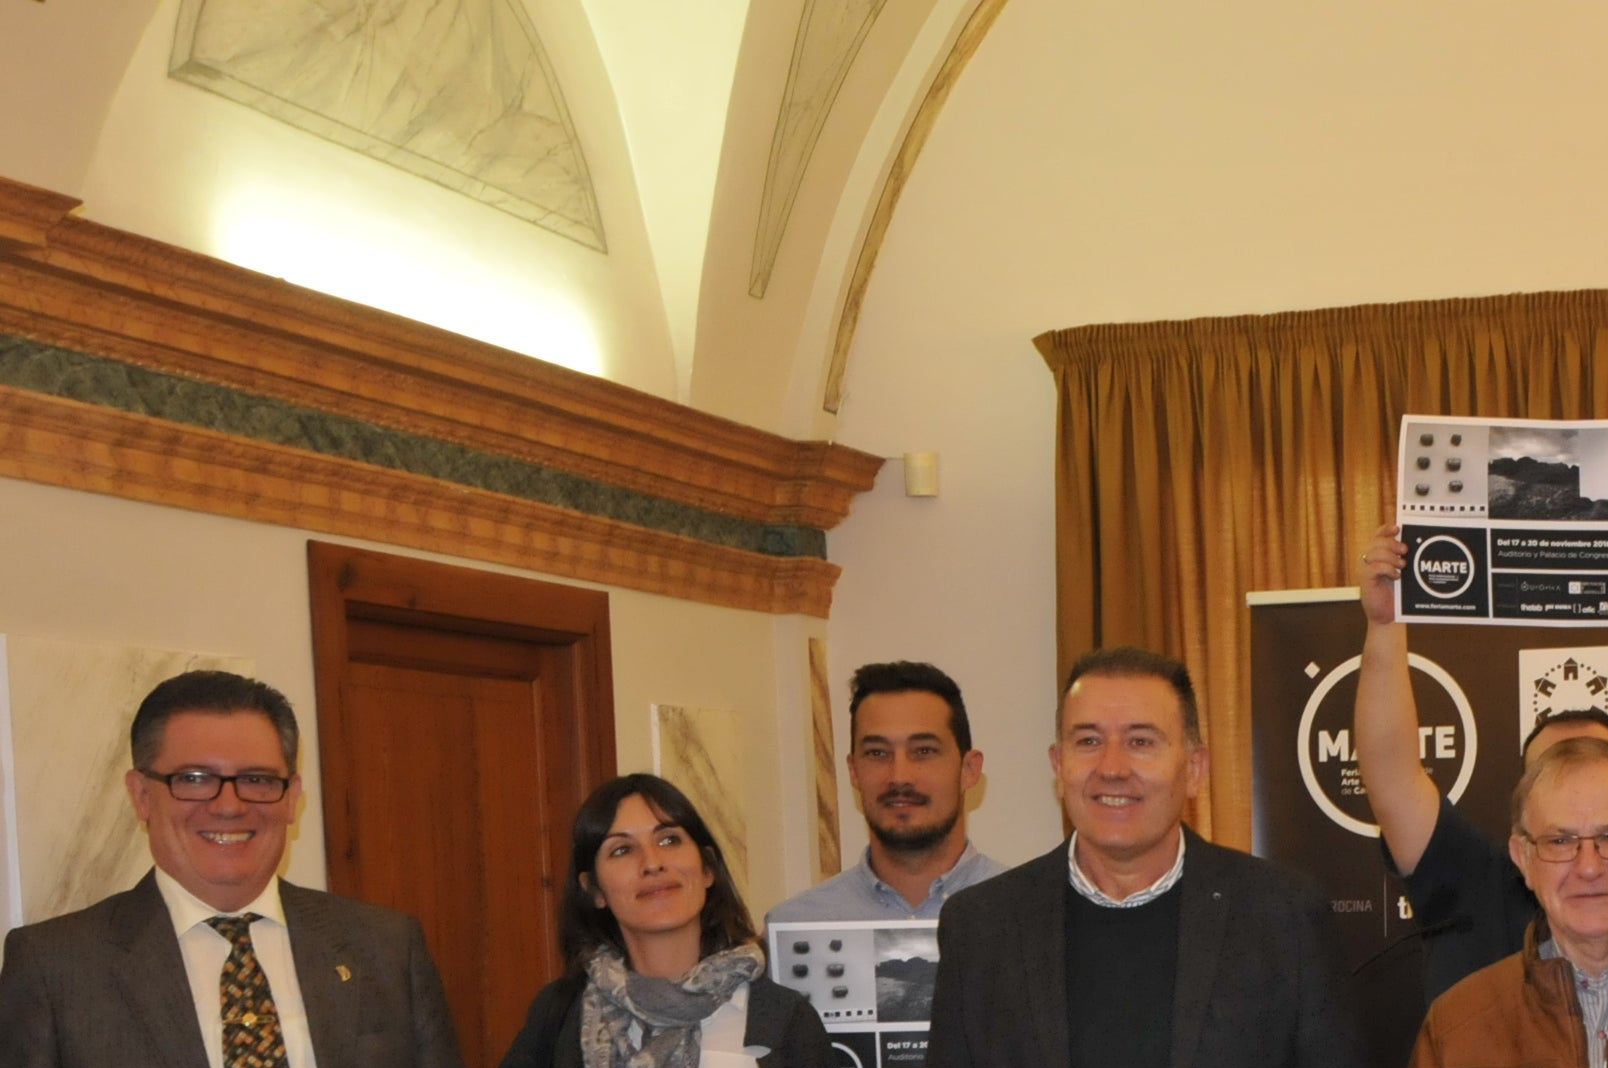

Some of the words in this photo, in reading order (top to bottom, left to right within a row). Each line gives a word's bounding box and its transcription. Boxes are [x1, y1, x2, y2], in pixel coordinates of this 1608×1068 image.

[1527, 539, 1538, 547] 20
[1539, 539, 1549, 547] de
[1420, 560, 1468, 574] MARTE
[1318, 725, 1456, 763] MTE
